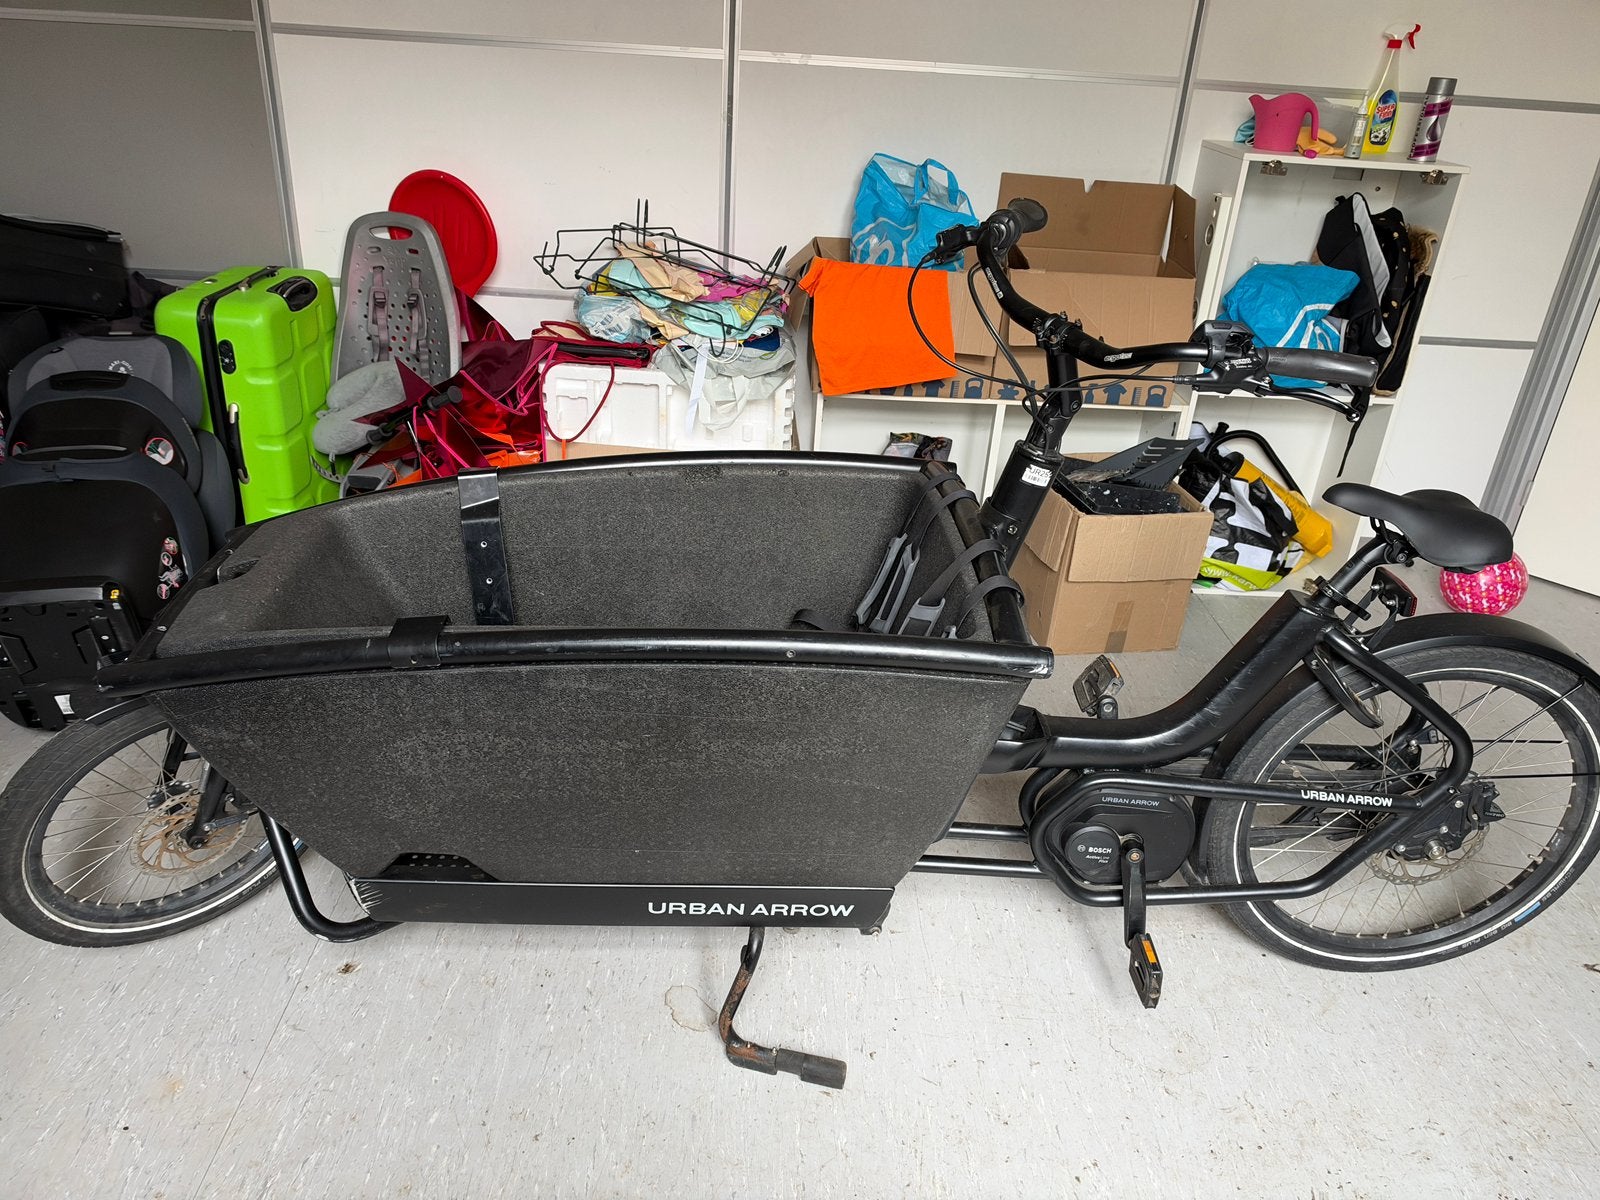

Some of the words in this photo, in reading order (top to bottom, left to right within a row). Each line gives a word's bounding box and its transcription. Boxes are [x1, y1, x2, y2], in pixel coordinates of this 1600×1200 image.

[1102, 796, 1130, 804] URBAN
[1130, 799, 1160, 807] ARROW
[1301, 789, 1345, 803] URBAN
[1346, 794, 1393, 807] ARROW
[1088, 846, 1112, 854] BOSCH
[647, 902, 745, 916] URBAN
[750, 903, 856, 917] ARROW
